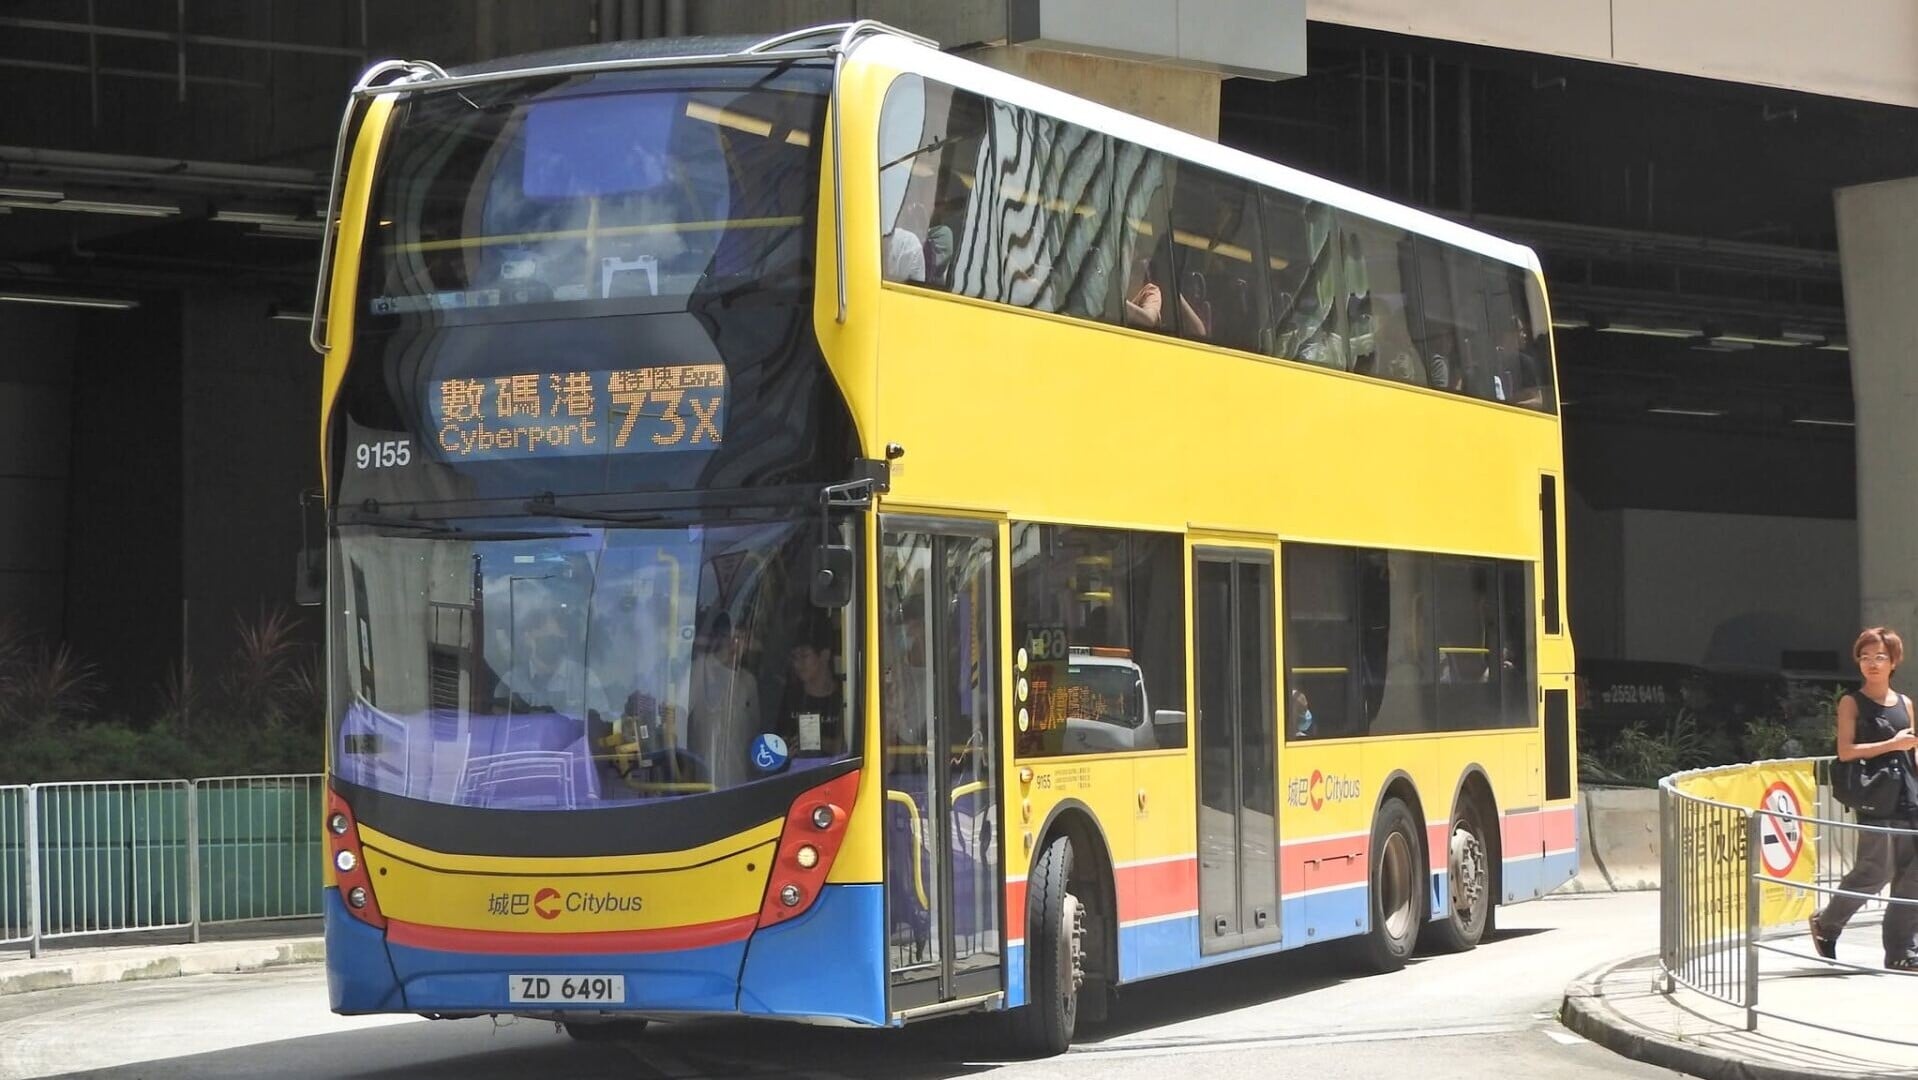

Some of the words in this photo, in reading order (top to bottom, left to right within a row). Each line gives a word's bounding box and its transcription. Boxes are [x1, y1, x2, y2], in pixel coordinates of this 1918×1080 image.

[440, 371, 595, 423] 數碼港
[612, 390, 722, 447] 73X
[439, 416, 597, 455] Cyberport
[356, 440, 411, 469] 9155
[1036, 774, 1051, 790] 9155
[1288, 778, 1308, 807] 城巴
[1325, 774, 1361, 802] Citybus
[488, 893, 530, 916] 城巴
[565, 891, 643, 915] Citybus
[521, 977, 550, 1000] ZD
[561, 977, 613, 1000] 6491
